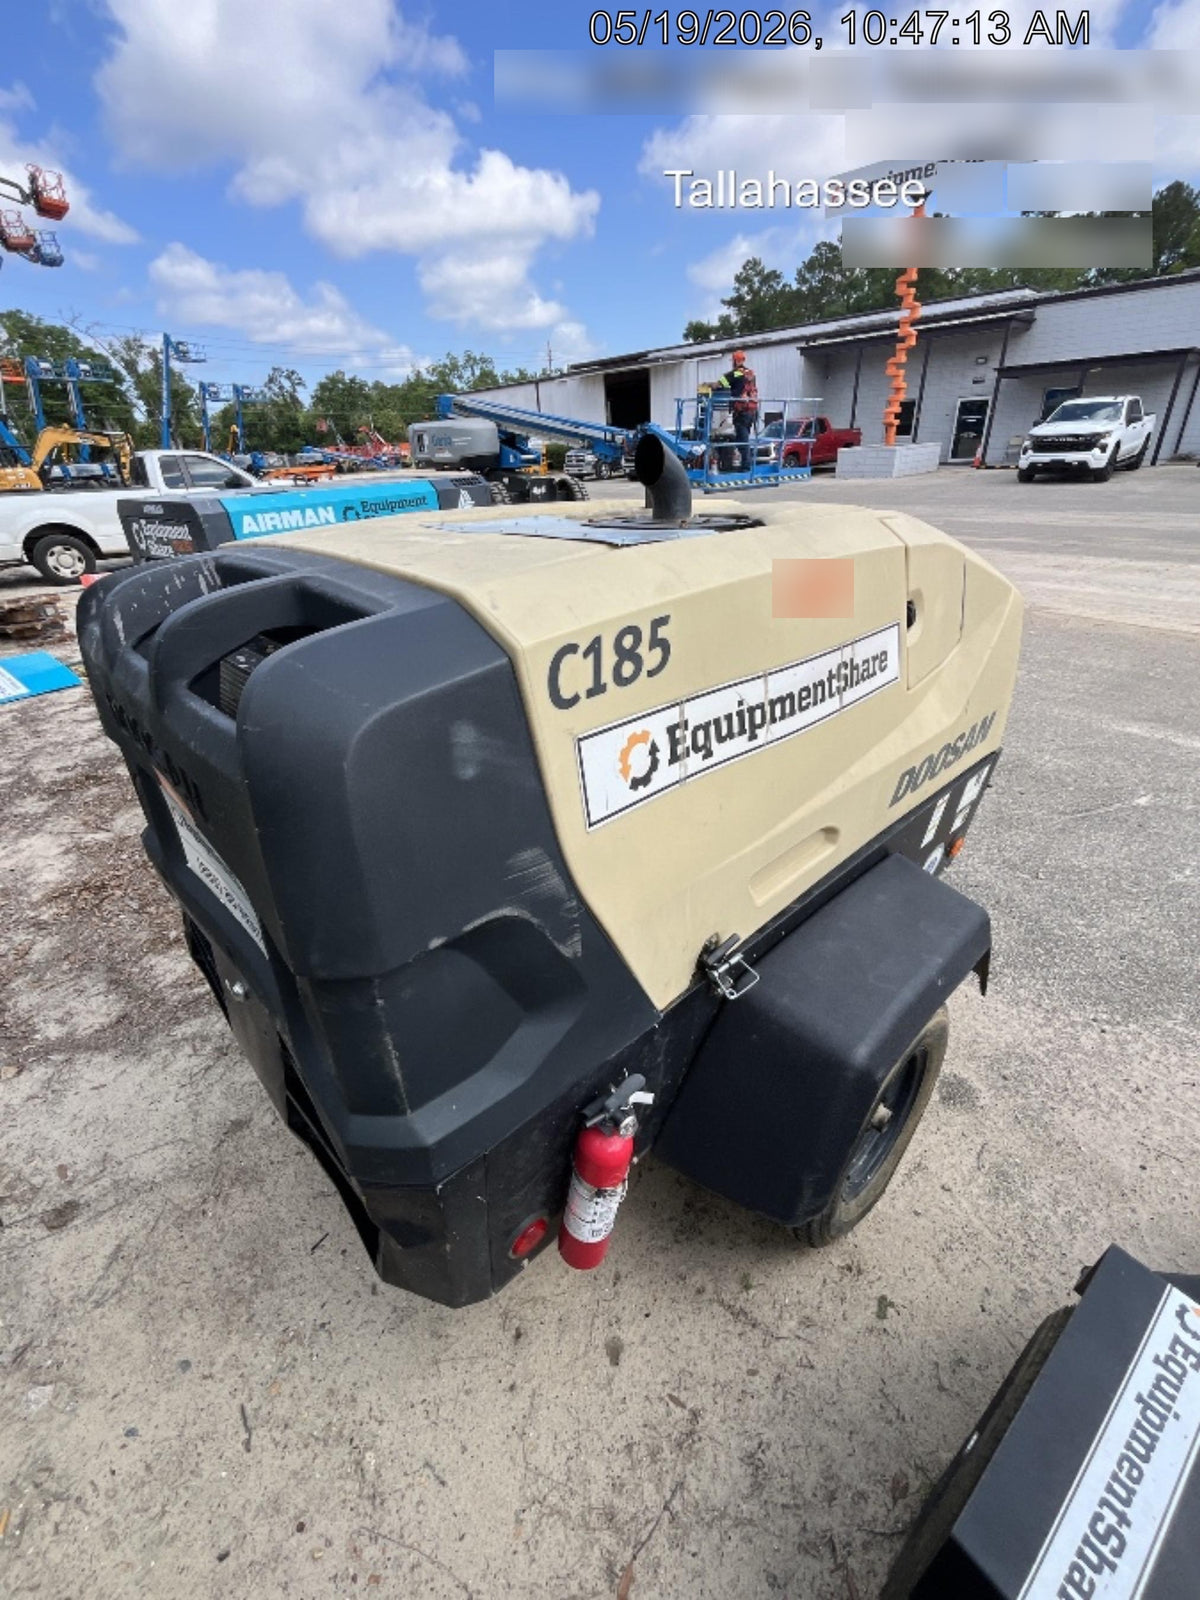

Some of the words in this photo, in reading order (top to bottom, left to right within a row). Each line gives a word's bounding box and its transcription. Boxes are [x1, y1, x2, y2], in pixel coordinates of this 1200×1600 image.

[242, 505, 337, 534] AIRMAN
[360, 494, 428, 514] Equipment
[547, 614, 671, 710] C185
[666, 649, 889, 762] EquipmentShare
[888, 710, 997, 808] DOOSAN
